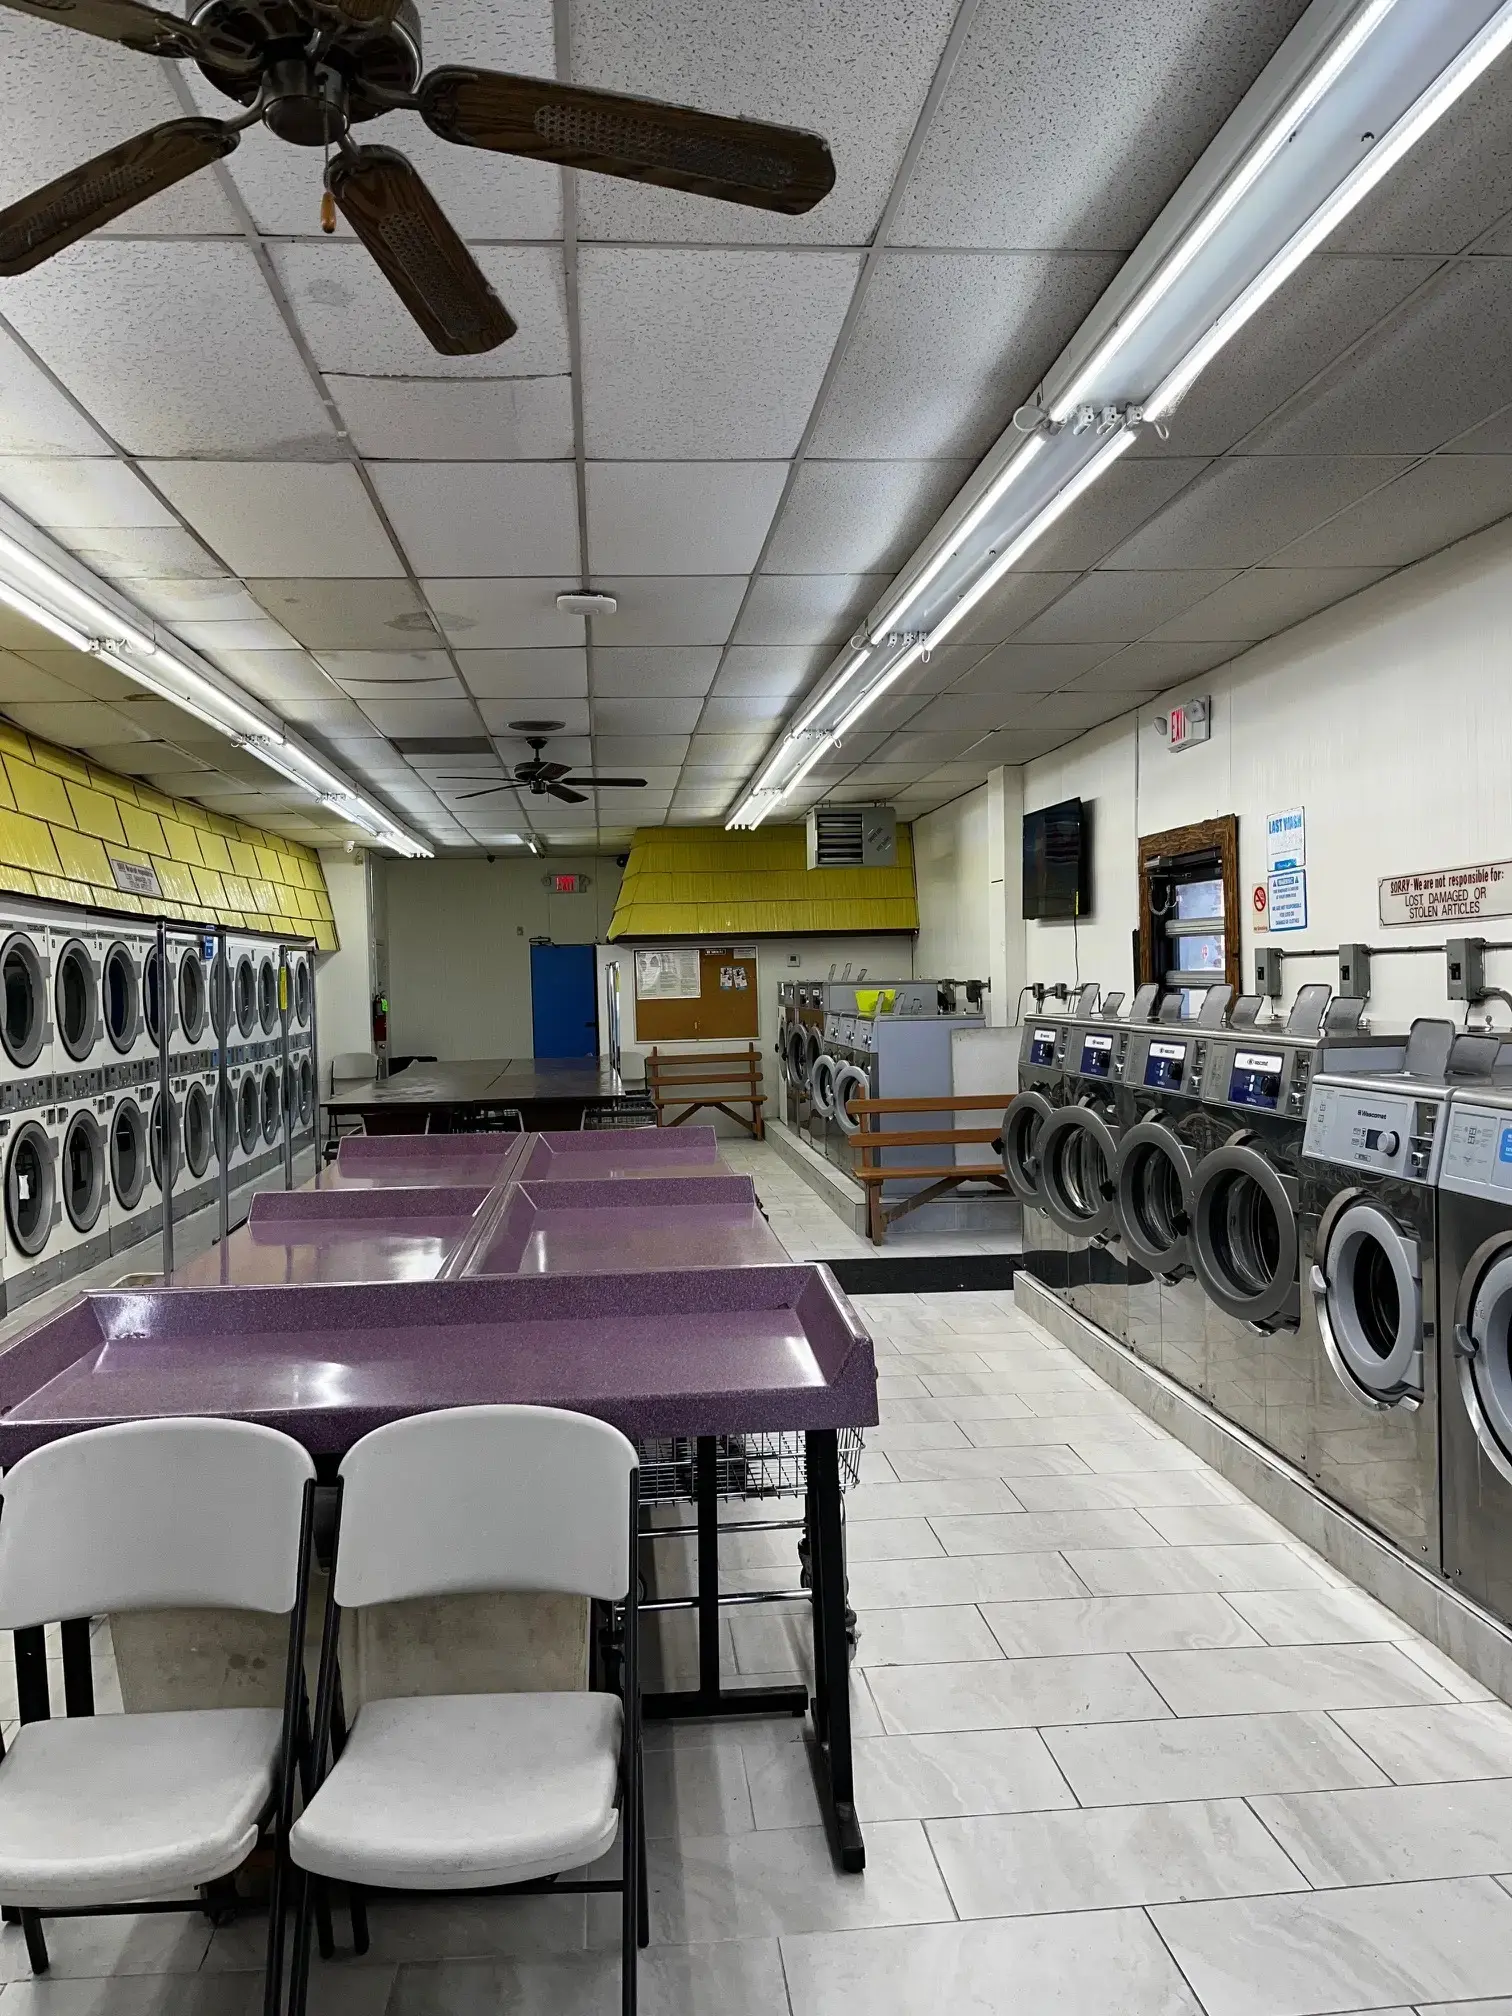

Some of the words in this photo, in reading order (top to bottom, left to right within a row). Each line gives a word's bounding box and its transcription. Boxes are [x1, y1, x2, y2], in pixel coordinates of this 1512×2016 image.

[1171, 708, 1184, 743] EXIT
[1269, 819, 1282, 834] LAST
[556, 876, 576, 892] EXIT
[1423, 879, 1433, 890] are
[1435, 875, 1446, 888] not
[1448, 868, 1489, 887] responsible
[1490, 867, 1504, 881] for:
[1405, 893, 1424, 907] LOST
[1428, 889, 1469, 905] DAMAGED
[1473, 886, 1487, 900] OR
[1409, 905, 1438, 919] STOLEN
[1441, 900, 1480, 916] ARTICLES
